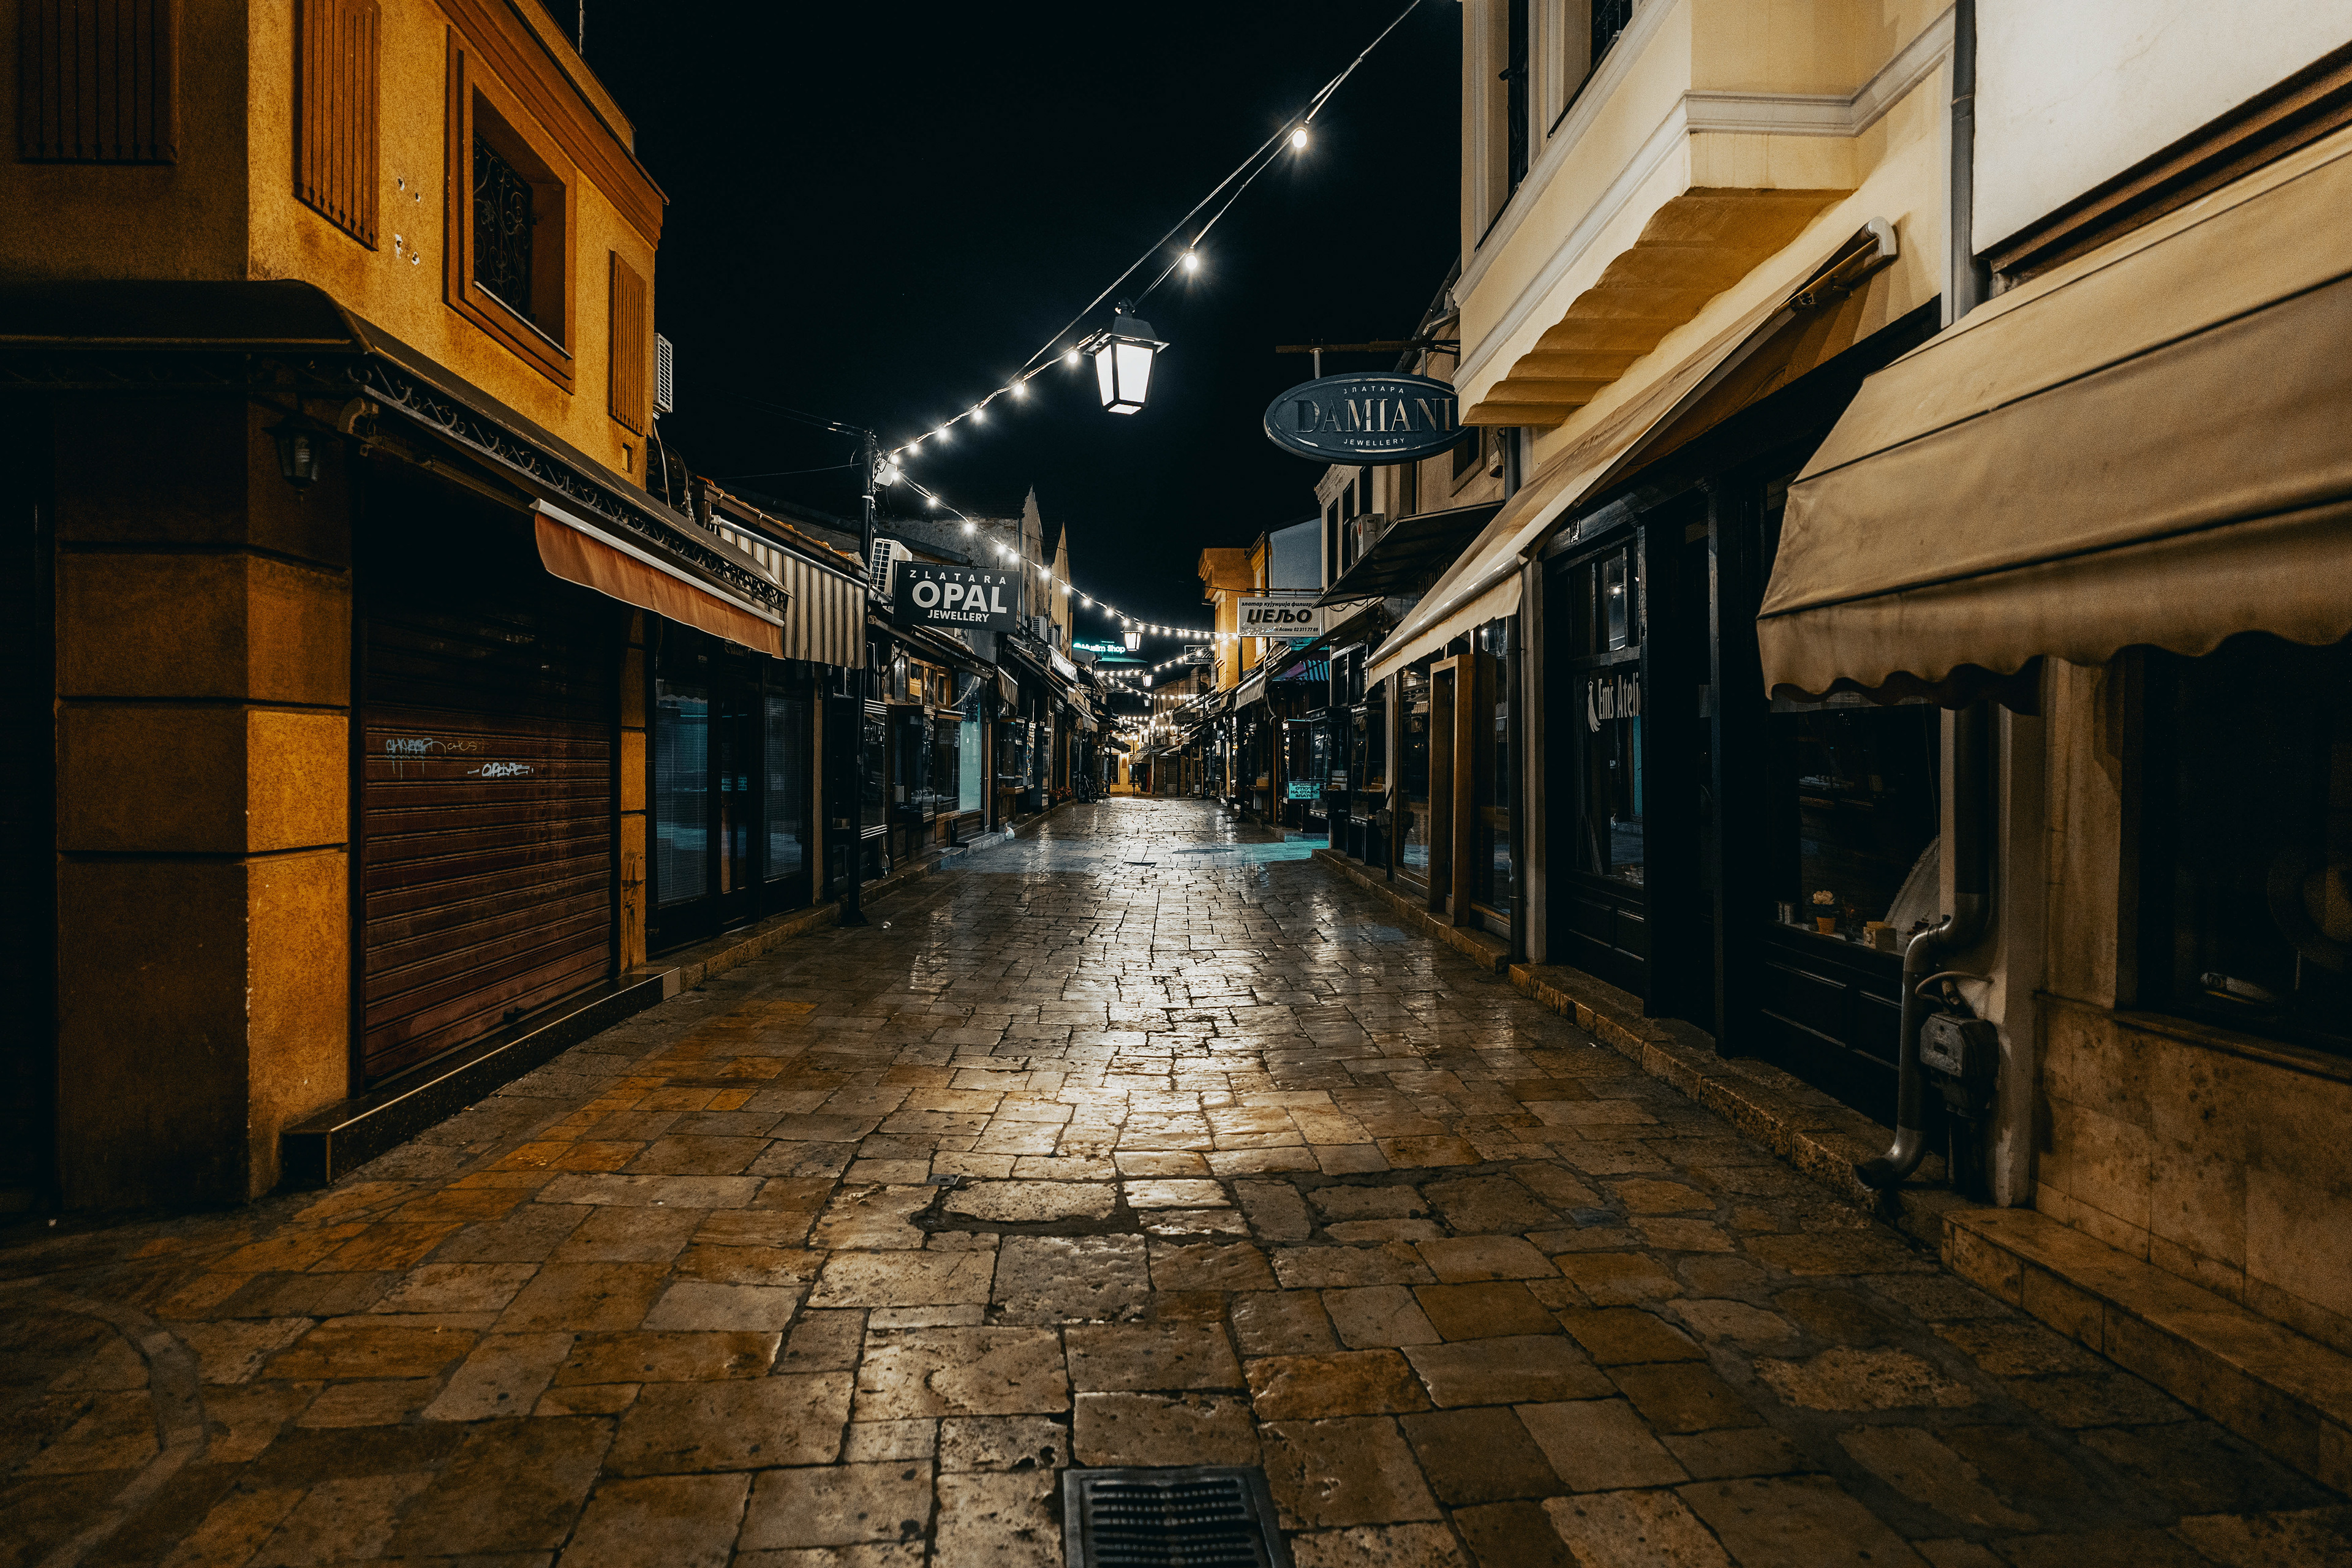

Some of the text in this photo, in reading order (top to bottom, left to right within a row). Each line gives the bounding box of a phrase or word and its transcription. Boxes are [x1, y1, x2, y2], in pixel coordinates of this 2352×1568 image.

[1294, 398, 1453, 432] DAMIANI
[1344, 437, 1404, 446] JEWELLERY
[909, 570, 1006, 585] ZLATARA
[912, 581, 1007, 614] OPAL
[927, 609, 990, 622] JEWELLERY
[1246, 609, 1313, 624] ЏЕЉО
[1107, 644, 1126, 654] Shop
[1617, 672, 1640, 718] Ateli
